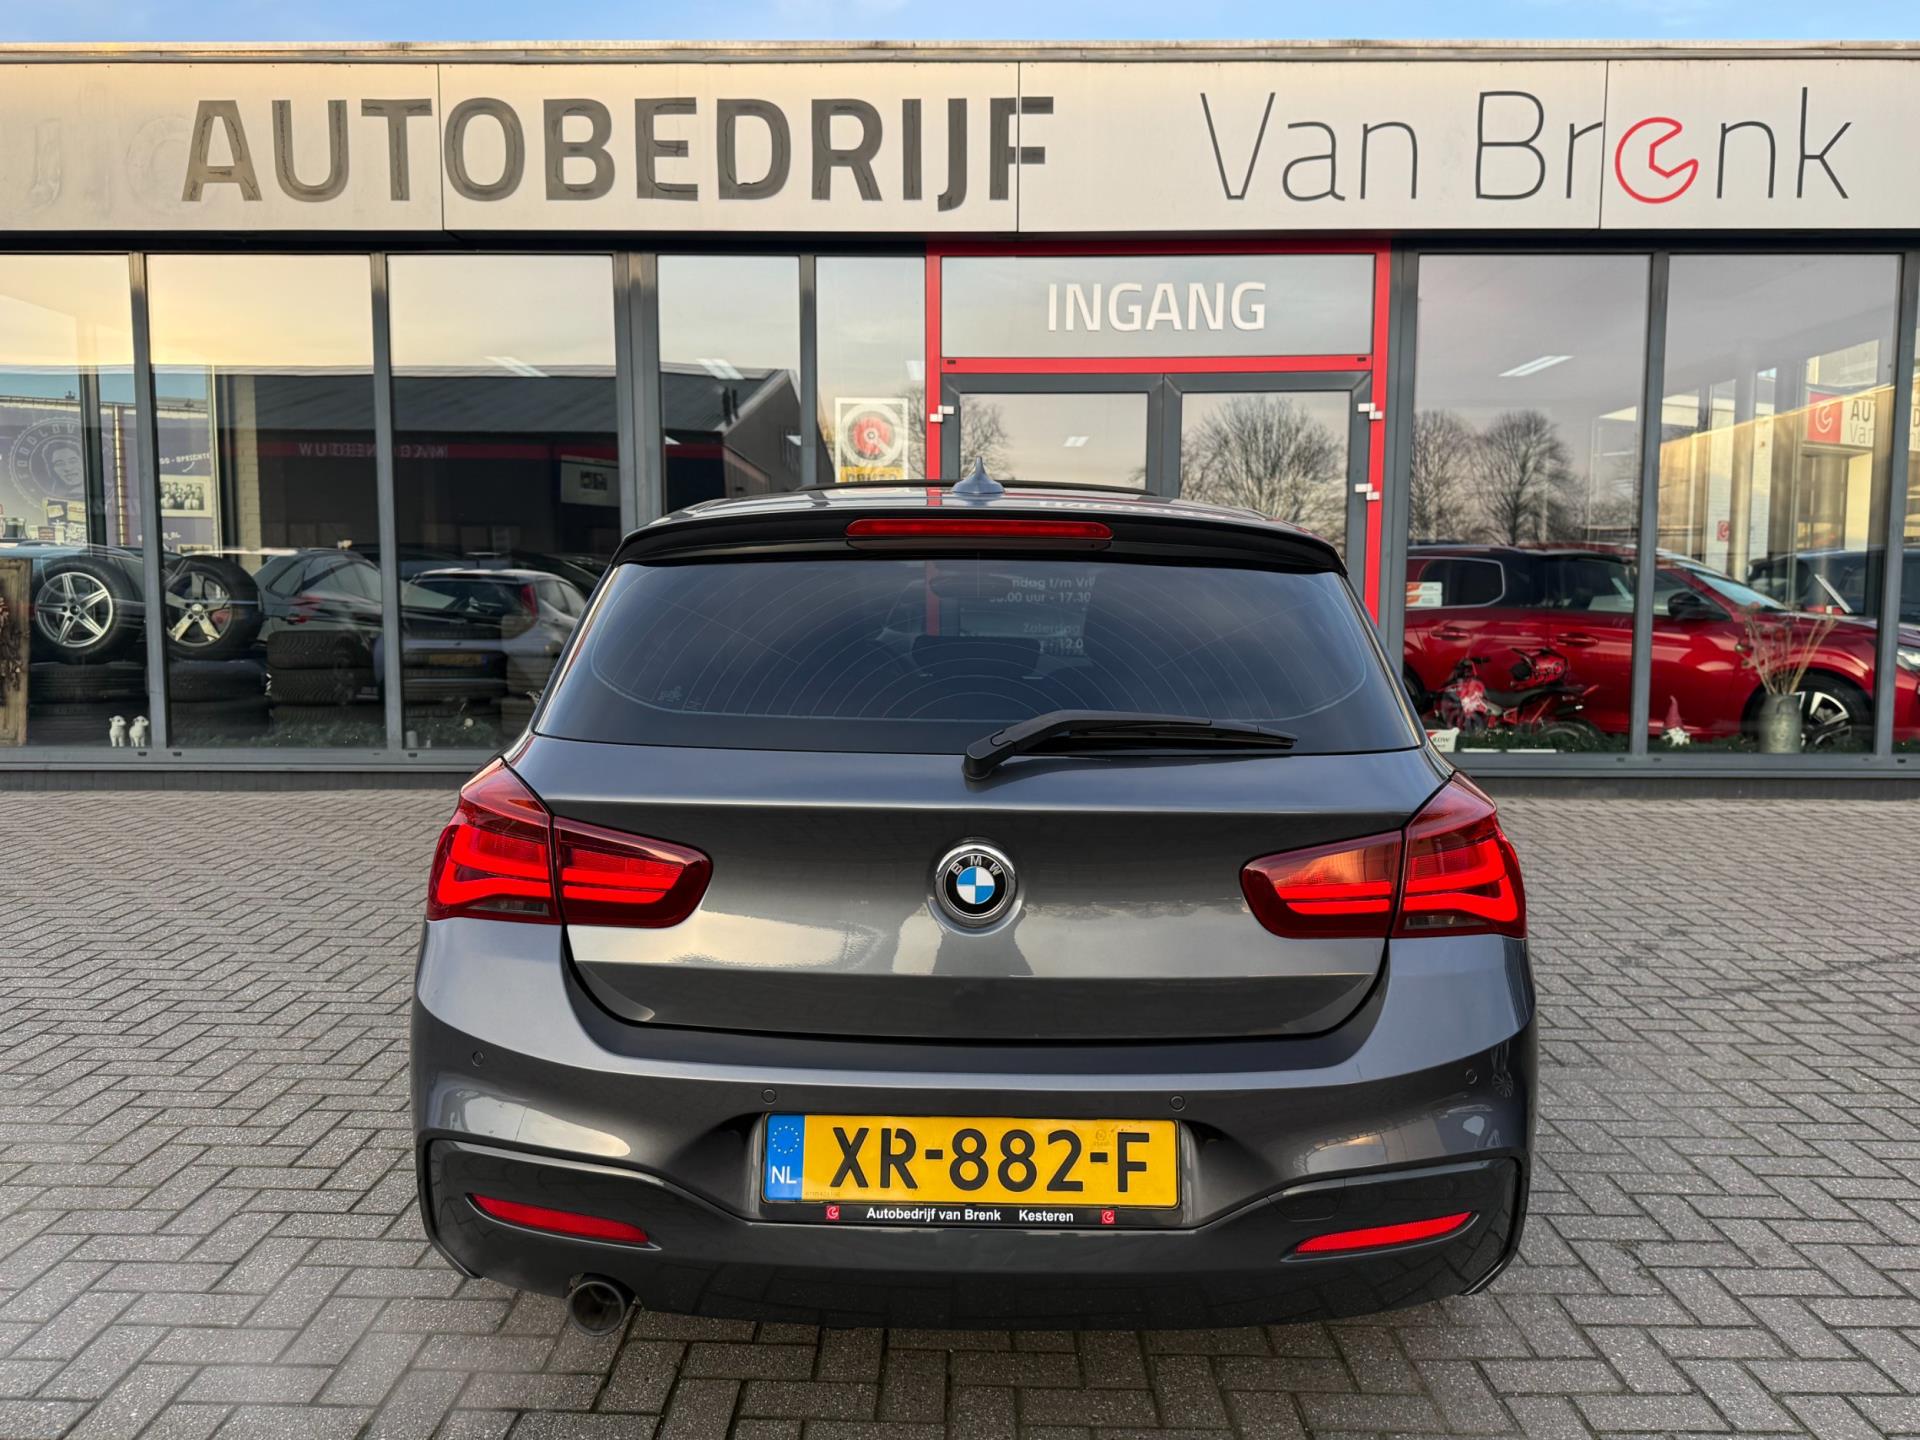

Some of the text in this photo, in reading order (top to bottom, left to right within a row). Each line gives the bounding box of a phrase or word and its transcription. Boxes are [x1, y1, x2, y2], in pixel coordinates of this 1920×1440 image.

[183, 96, 1053, 212] AUTOBEDRIJF
[1201, 92, 1418, 202] Van
[1048, 281, 1267, 332] INGANG
[950, 855, 1002, 876] BMW
[771, 1165, 798, 1185] NL
[830, 1126, 1150, 1193] XR-882-F
[866, 1207, 1075, 1223] Autobedrijf van Brenk Kesteren
